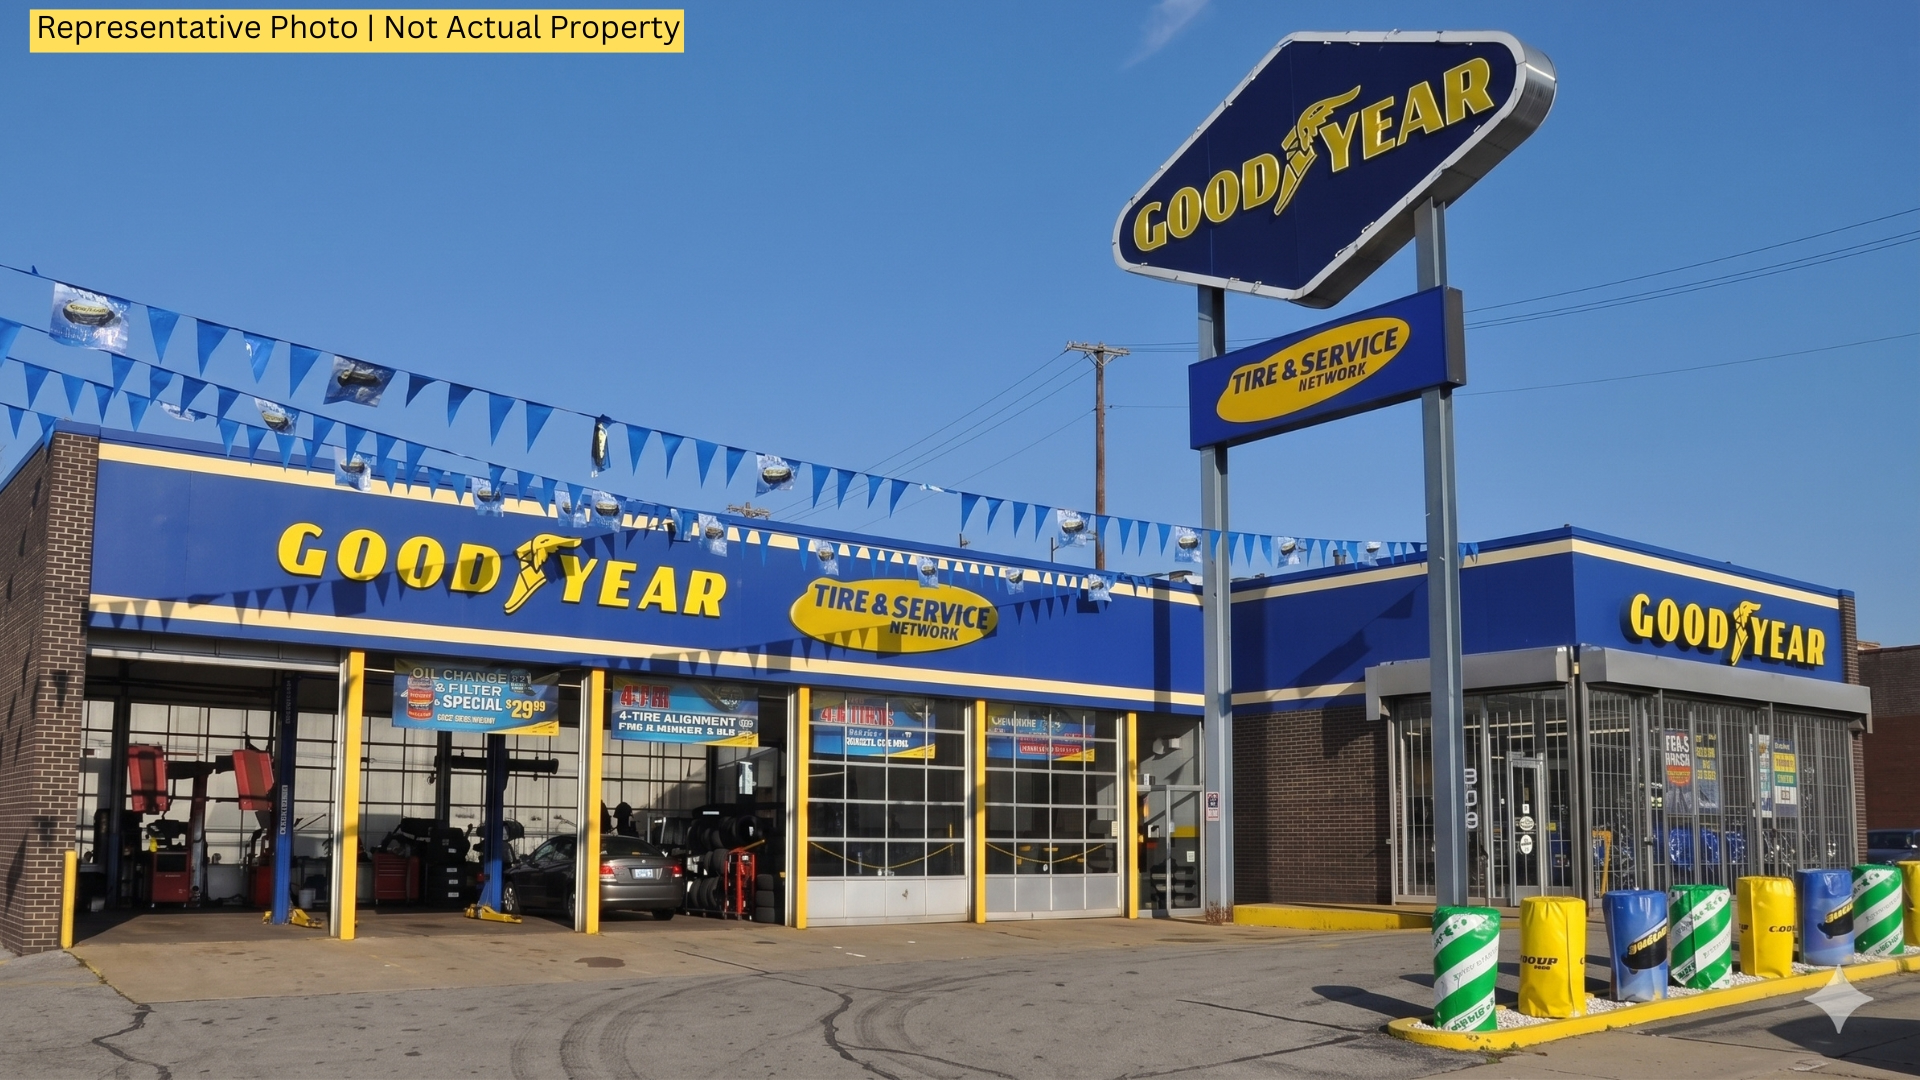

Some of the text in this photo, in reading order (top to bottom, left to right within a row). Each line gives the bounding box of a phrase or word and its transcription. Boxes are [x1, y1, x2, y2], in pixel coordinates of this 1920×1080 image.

[1232, 327, 1399, 395] TIRE & SERVICE
[1298, 361, 1367, 393] NETWORK
[814, 584, 990, 630] TIRE & SERVICE
[889, 619, 960, 642] NETWORK
[412, 667, 440, 680] OIL
[443, 669, 508, 685] CHANGE
[435, 682, 446, 692] &
[448, 683, 502, 697] FILTER
[443, 694, 503, 712] SPECIAL
[618, 710, 661, 723] 4-TIRE
[663, 713, 737, 727] ALIGNMENT
